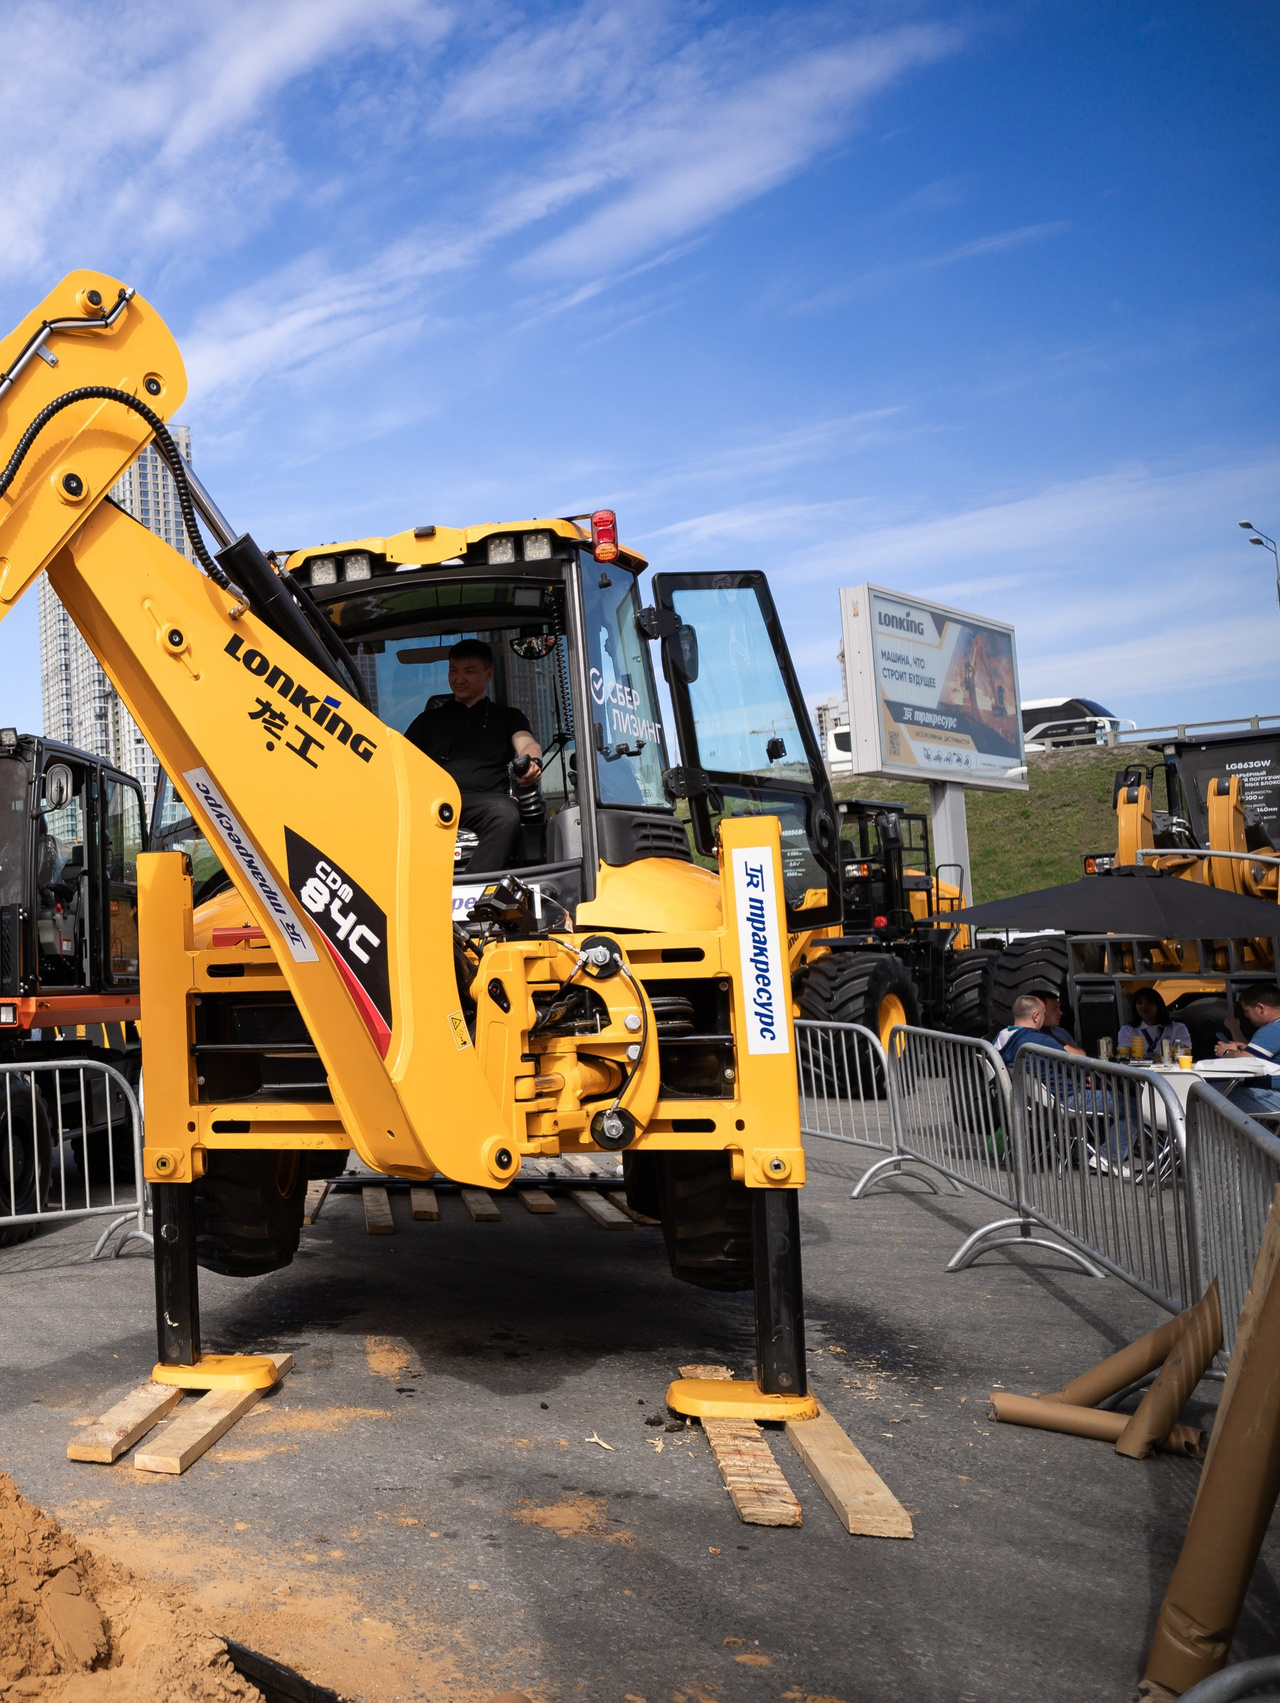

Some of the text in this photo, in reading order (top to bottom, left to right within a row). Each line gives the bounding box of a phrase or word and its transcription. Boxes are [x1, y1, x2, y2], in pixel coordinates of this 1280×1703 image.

[882, 667, 936, 689] СТРОИТ БУДУЩЕЕ
[913, 658, 926, 670] ЧТО
[607, 681, 641, 711] СБЕР
[613, 708, 662, 745] ЛИЗИНГ
[315, 861, 354, 903] CDM
[301, 876, 381, 965] 84C
